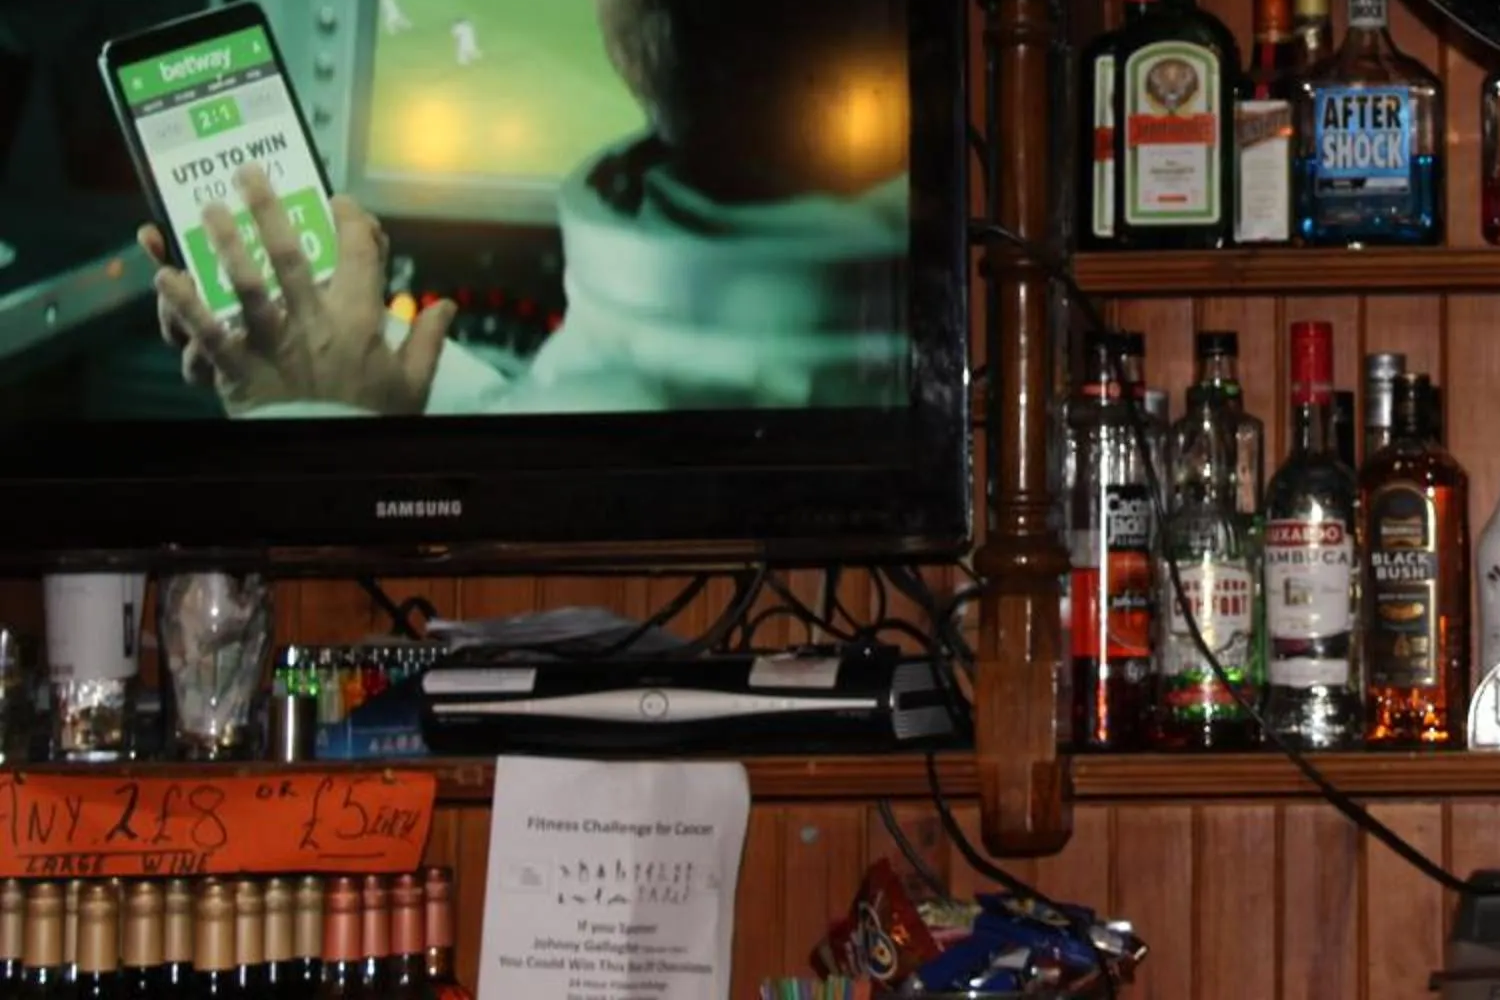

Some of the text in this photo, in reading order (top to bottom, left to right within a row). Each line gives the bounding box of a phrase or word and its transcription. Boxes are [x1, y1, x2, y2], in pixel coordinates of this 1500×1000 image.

[159, 46, 233, 84] betway
[1323, 96, 1402, 130] AFTER
[171, 132, 288, 185] UTD TO WIN
[1322, 136, 1403, 171] SHOCK
[375, 499, 462, 519] SAMSUNG
[1371, 551, 1429, 567] BLACK
[1376, 566, 1426, 581] BUSH
[255, 778, 300, 800] OR
[527, 815, 715, 839] Fitness Challenge for Cancer
